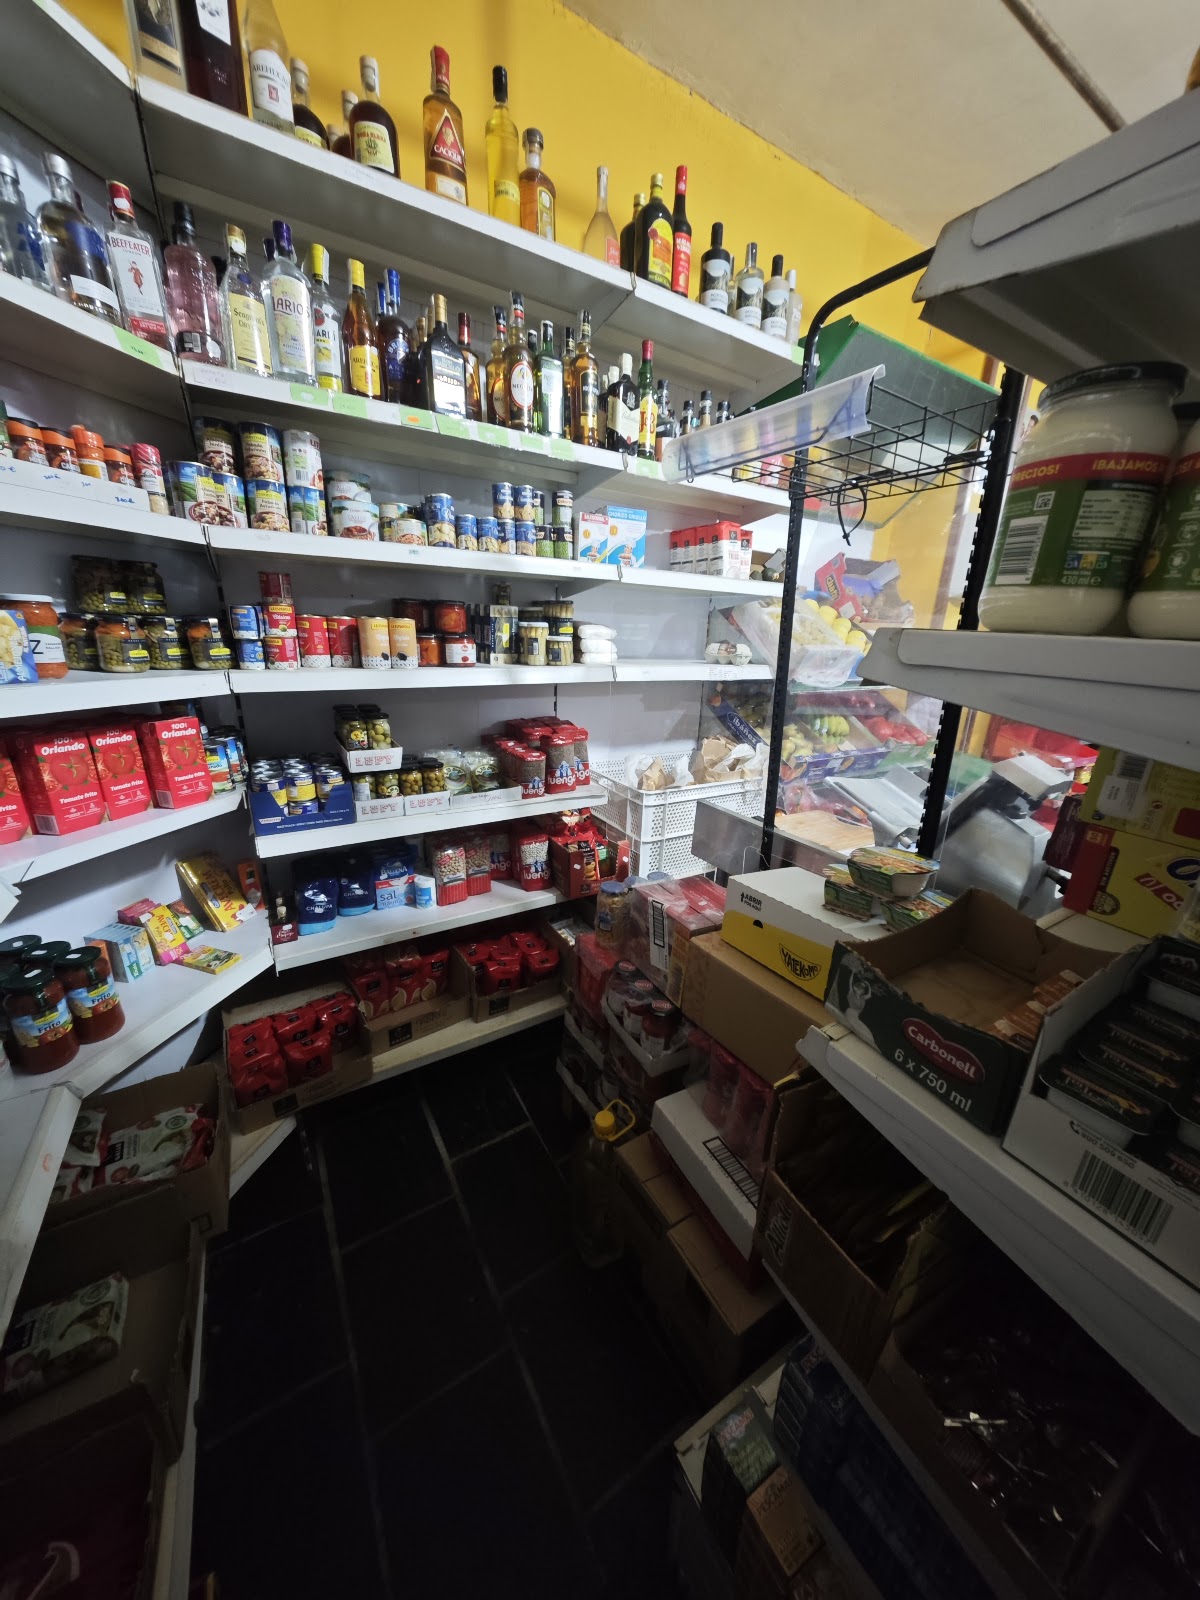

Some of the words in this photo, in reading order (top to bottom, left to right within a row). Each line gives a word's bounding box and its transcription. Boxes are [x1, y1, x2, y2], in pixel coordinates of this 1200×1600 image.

[434, 144, 462, 165] CACIQUE
[110, 236, 150, 255] BEEFEATER
[272, 296, 311, 318] LARIOS
[1061, 575, 1076, 585] 430
[162, 727, 197, 739] Orlando
[95, 734, 133, 747] Orlando
[41, 742, 85, 756] Orlando
[174, 774, 192, 782] Tomate
[192, 770, 205, 778] frito
[110, 782, 130, 791] Tomate
[130, 779, 144, 788] frito
[59, 794, 83, 805] Tomate
[83, 790, 98, 801] frito
[490, 860, 512, 871] engo
[225, 879, 237, 896] Pollo
[380, 890, 397, 902] sal
[744, 893, 763, 907] ABRIR
[781, 947, 822, 979] YATEKOMO
[91, 993, 111, 1005] Frito
[38, 1020, 61, 1034] Frito
[907, 1025, 976, 1079] Carbonell
[894, 1048, 904, 1063] 6
[906, 1058, 916, 1070] x
[918, 1066, 947, 1095] 750
[951, 1089, 972, 1112] ml
